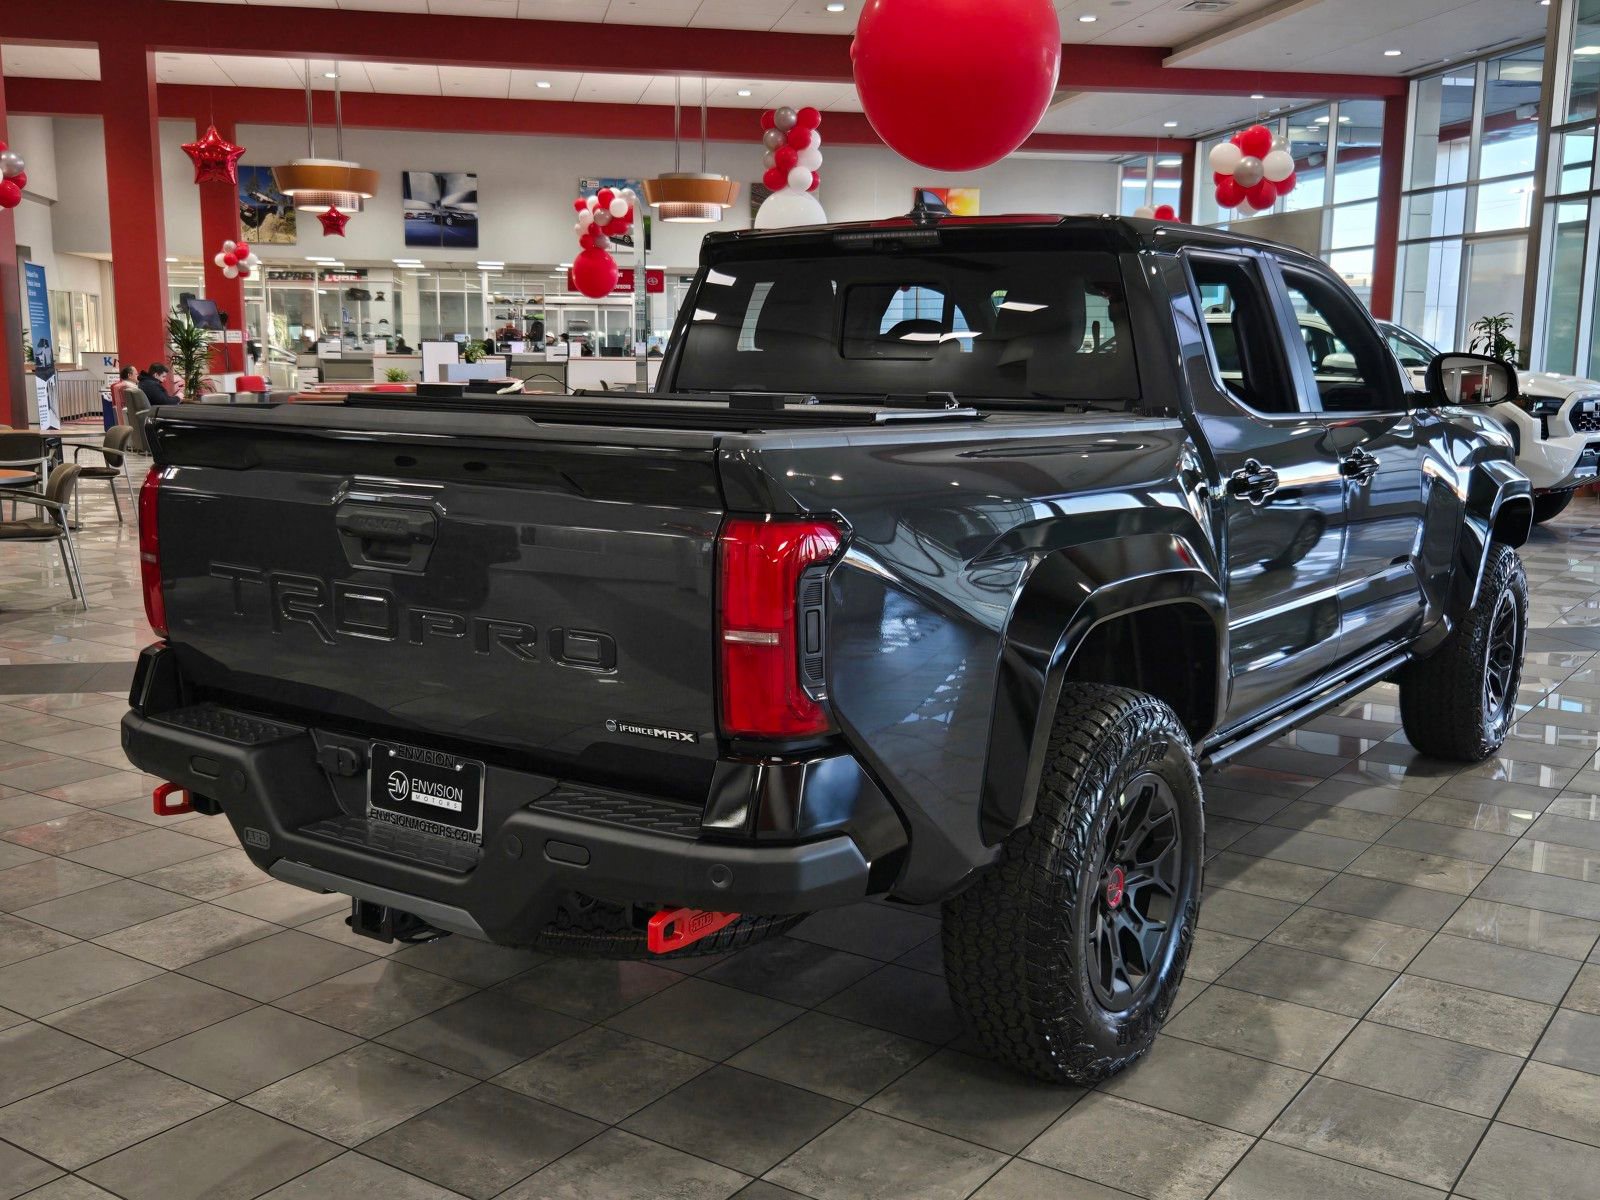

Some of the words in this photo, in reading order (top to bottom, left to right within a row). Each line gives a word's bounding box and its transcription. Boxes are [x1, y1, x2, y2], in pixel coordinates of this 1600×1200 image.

[407, 607, 618, 675] PRO
[399, 744, 455, 768] ENVISION
[411, 778, 463, 802] ENVISION
[415, 794, 457, 809] MOTORS
